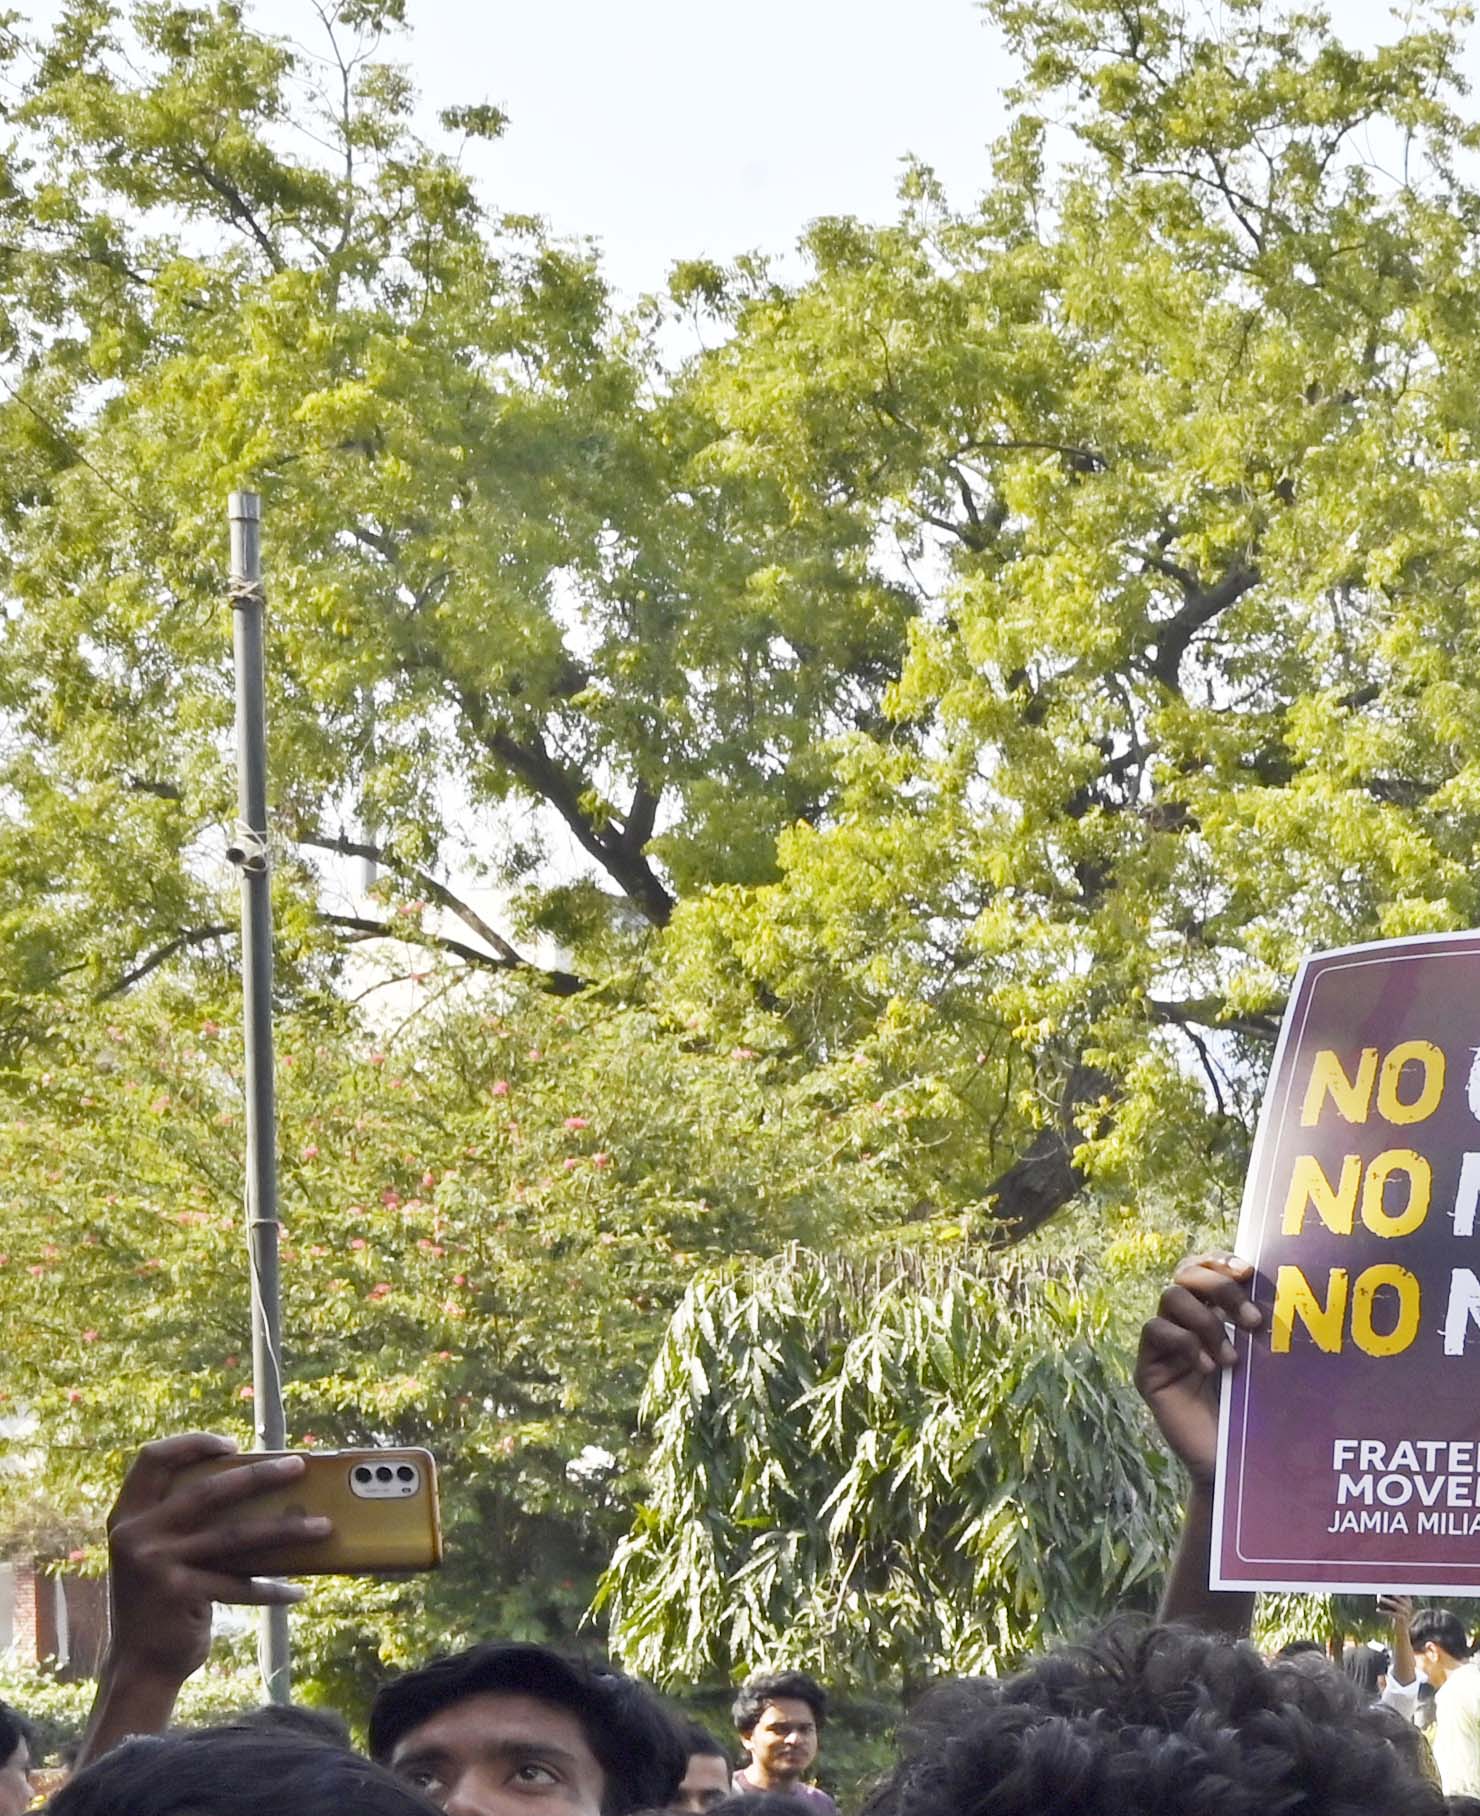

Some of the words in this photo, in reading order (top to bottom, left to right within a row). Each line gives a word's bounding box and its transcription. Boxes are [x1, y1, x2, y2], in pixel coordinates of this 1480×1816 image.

[1300, 1040, 1446, 1127] NO
[1281, 1149, 1432, 1238] NO
[1270, 1264, 1421, 1357] NO
[1327, 1510, 1409, 1534] JAMIA
